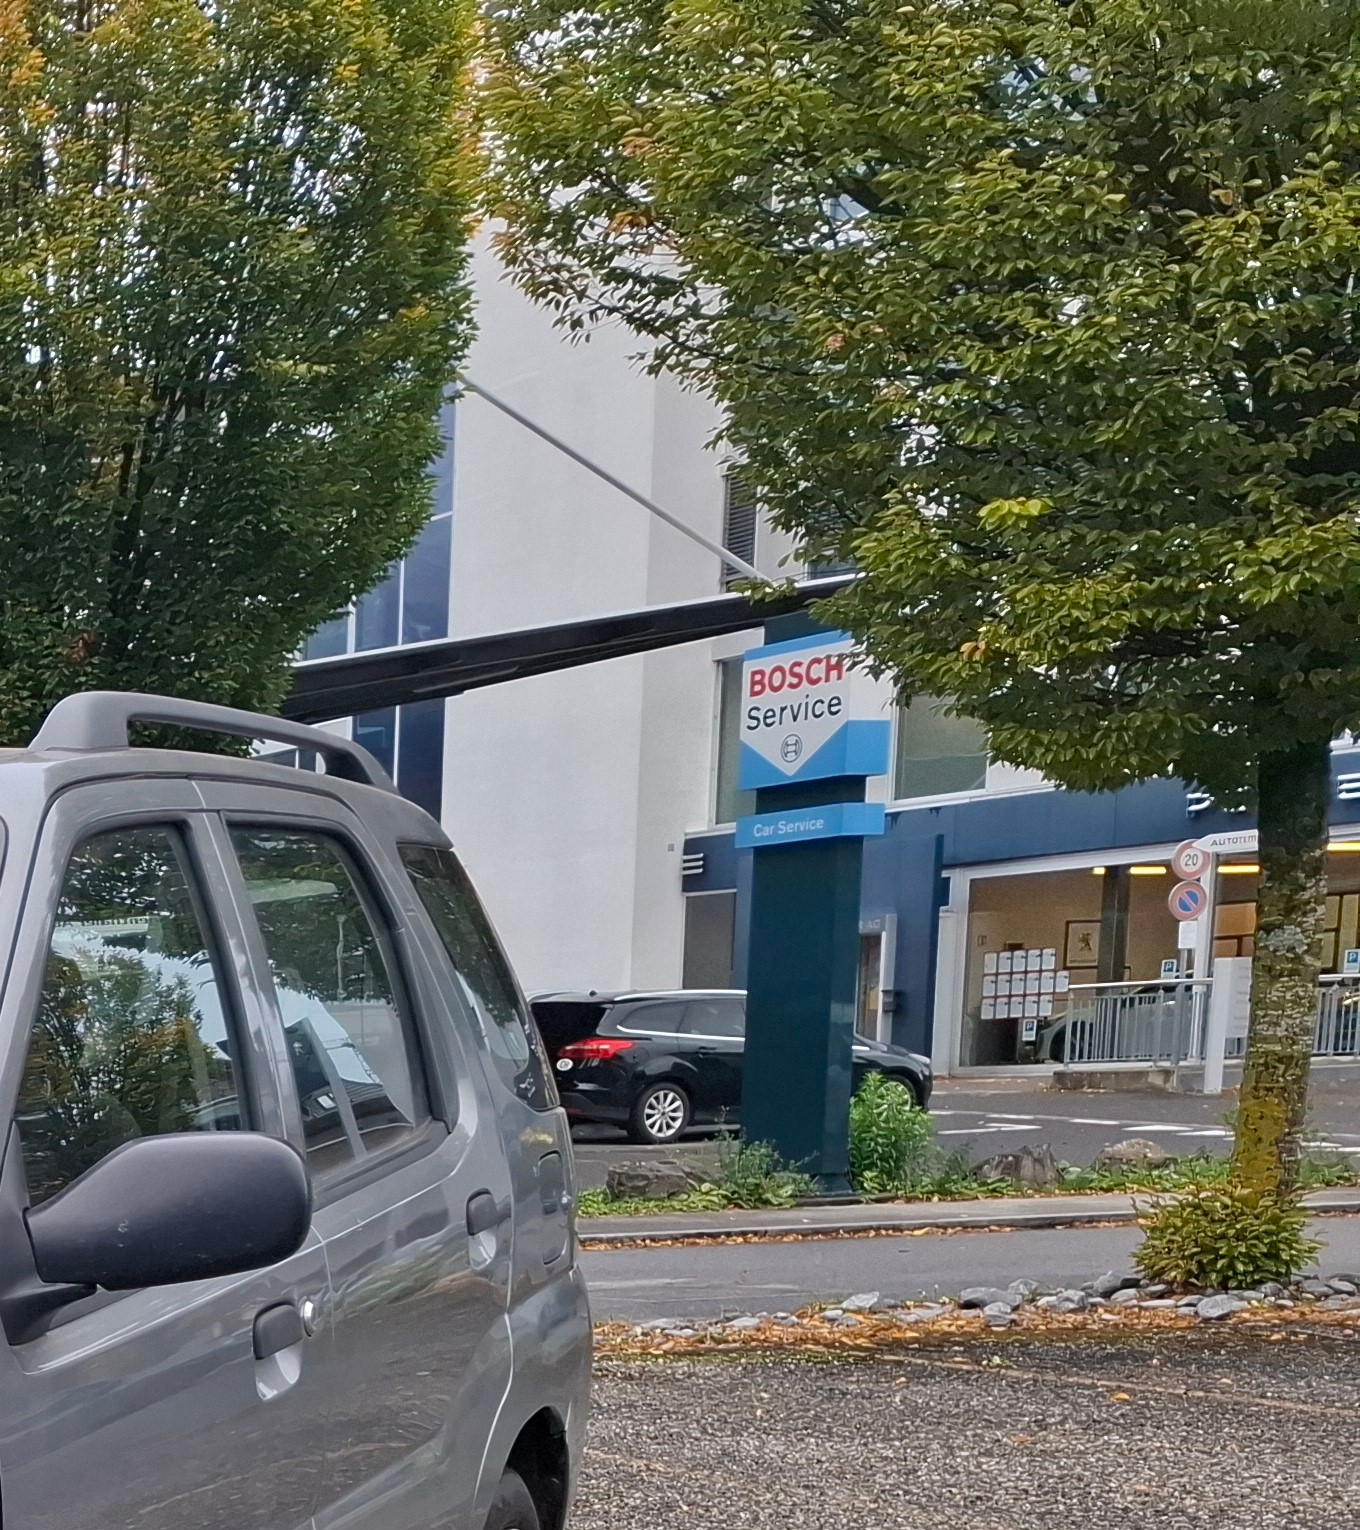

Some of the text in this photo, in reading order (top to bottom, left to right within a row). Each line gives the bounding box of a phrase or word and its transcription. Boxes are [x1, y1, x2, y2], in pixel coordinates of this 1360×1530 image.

[749, 656, 844, 697] BOSCH
[746, 694, 842, 730] Service
[753, 818, 824, 837] Car Service
[1184, 853, 1199, 867] 20
